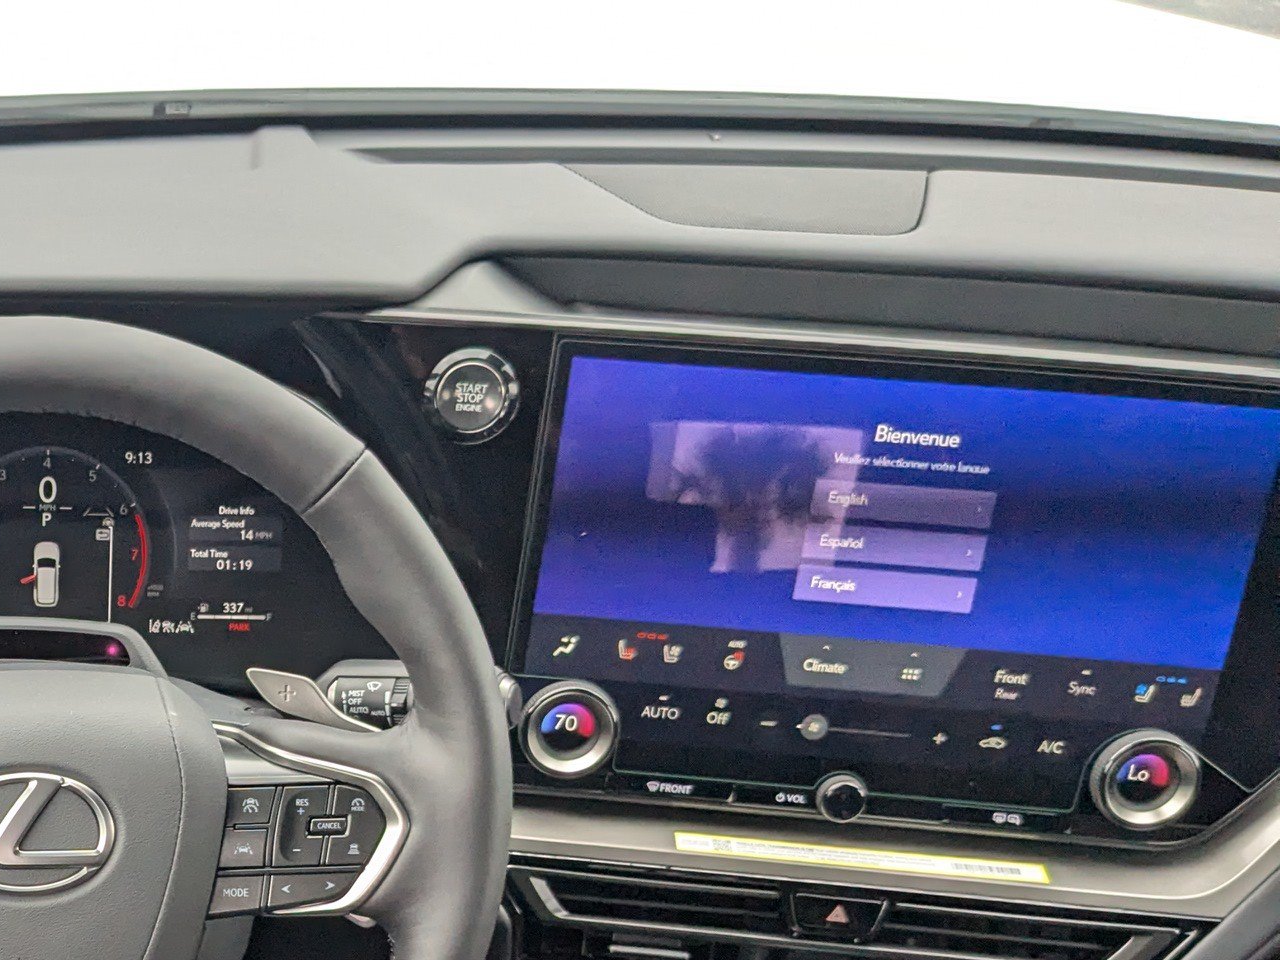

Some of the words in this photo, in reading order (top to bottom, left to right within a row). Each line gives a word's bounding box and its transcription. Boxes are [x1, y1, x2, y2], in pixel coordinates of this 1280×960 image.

[455, 382, 488, 394] START
[456, 393, 484, 403] STOP
[455, 404, 482, 412] ENGINE
[874, 423, 961, 449] Bienvenue
[42, 457, 52, 468] 4
[124, 451, 153, 465] 9:13
[0, 470, 6, 481] 3
[88, 470, 96, 482] 5
[38, 476, 58, 504] 0
[828, 490, 869, 507] English
[38, 503, 56, 512] MPH
[120, 504, 128, 515] 6
[218, 506, 239, 516] Drive
[240, 506, 255, 516] Info
[42, 512, 52, 527] P
[190, 519, 220, 529] Average
[222, 520, 245, 530] Speed
[240, 530, 254, 541] 14
[820, 534, 864, 551] Español
[190, 549, 209, 558] Total
[210, 550, 228, 559] Time
[216, 560, 254, 571] 01:19
[810, 576, 856, 593] Français
[117, 595, 126, 606] 8
[222, 602, 245, 614] 337
[190, 612, 196, 620] E
[228, 622, 251, 632] PARK
[803, 658, 848, 675] Climate
[994, 669, 1031, 686] Front
[1067, 682, 1098, 698] Sync
[348, 698, 362, 706] OFF
[349, 706, 369, 714] AUTO
[641, 706, 681, 720] AUTO
[555, 714, 578, 732] 70
[706, 711, 732, 726] Off
[1036, 740, 1068, 756] A/C
[1127, 764, 1150, 783] Lo
[660, 782, 694, 796] FRONT
[295, 798, 310, 807] RES
[786, 794, 808, 805] VOL
[316, 822, 342, 830] CANCEL
[222, 888, 250, 898] MODE
